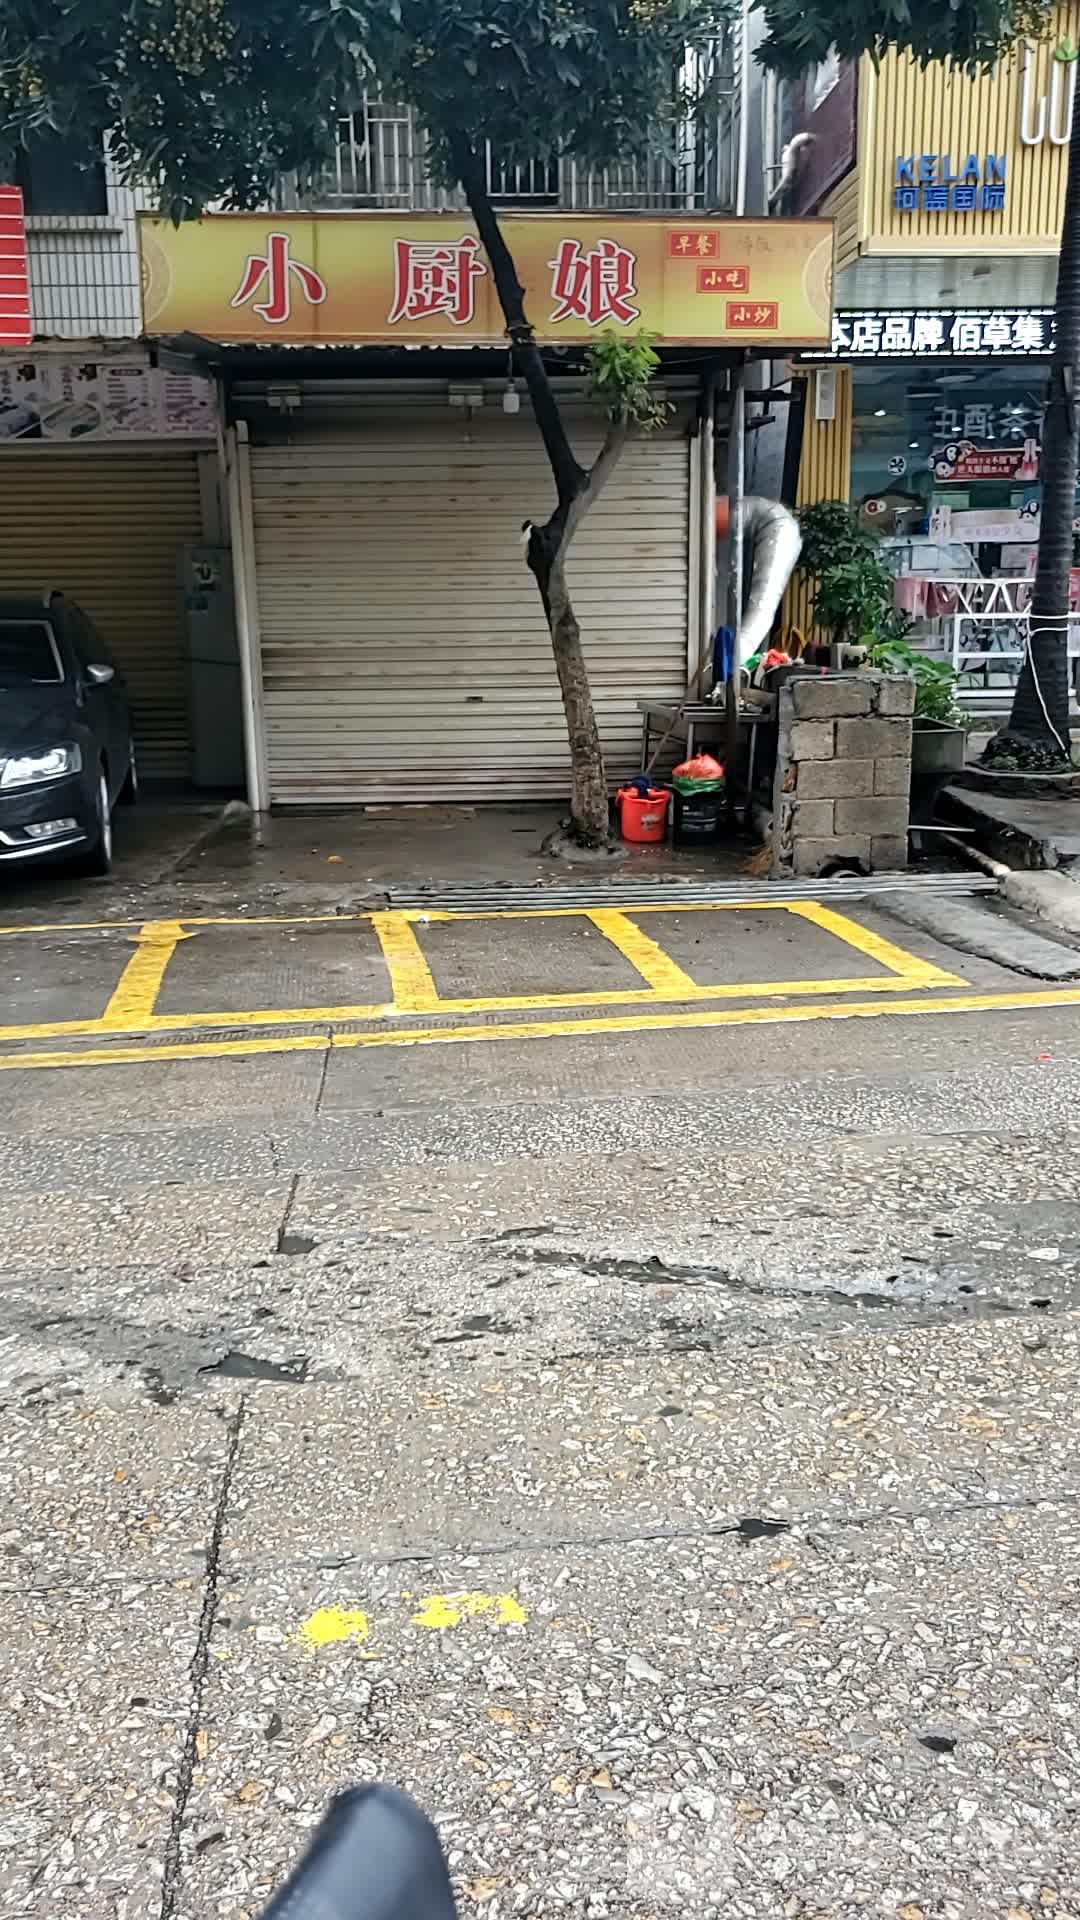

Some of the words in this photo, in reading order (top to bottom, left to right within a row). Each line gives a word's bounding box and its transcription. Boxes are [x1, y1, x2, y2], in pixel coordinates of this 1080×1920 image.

[896, 154, 1006, 181] KELAN
[675, 235, 713, 255] 早餐
[231, 232, 640, 327] 小厨娘
[704, 270, 744, 289] 小吃
[733, 306, 771, 324] 小炒
[950, 314, 1045, 350] 佰草集
